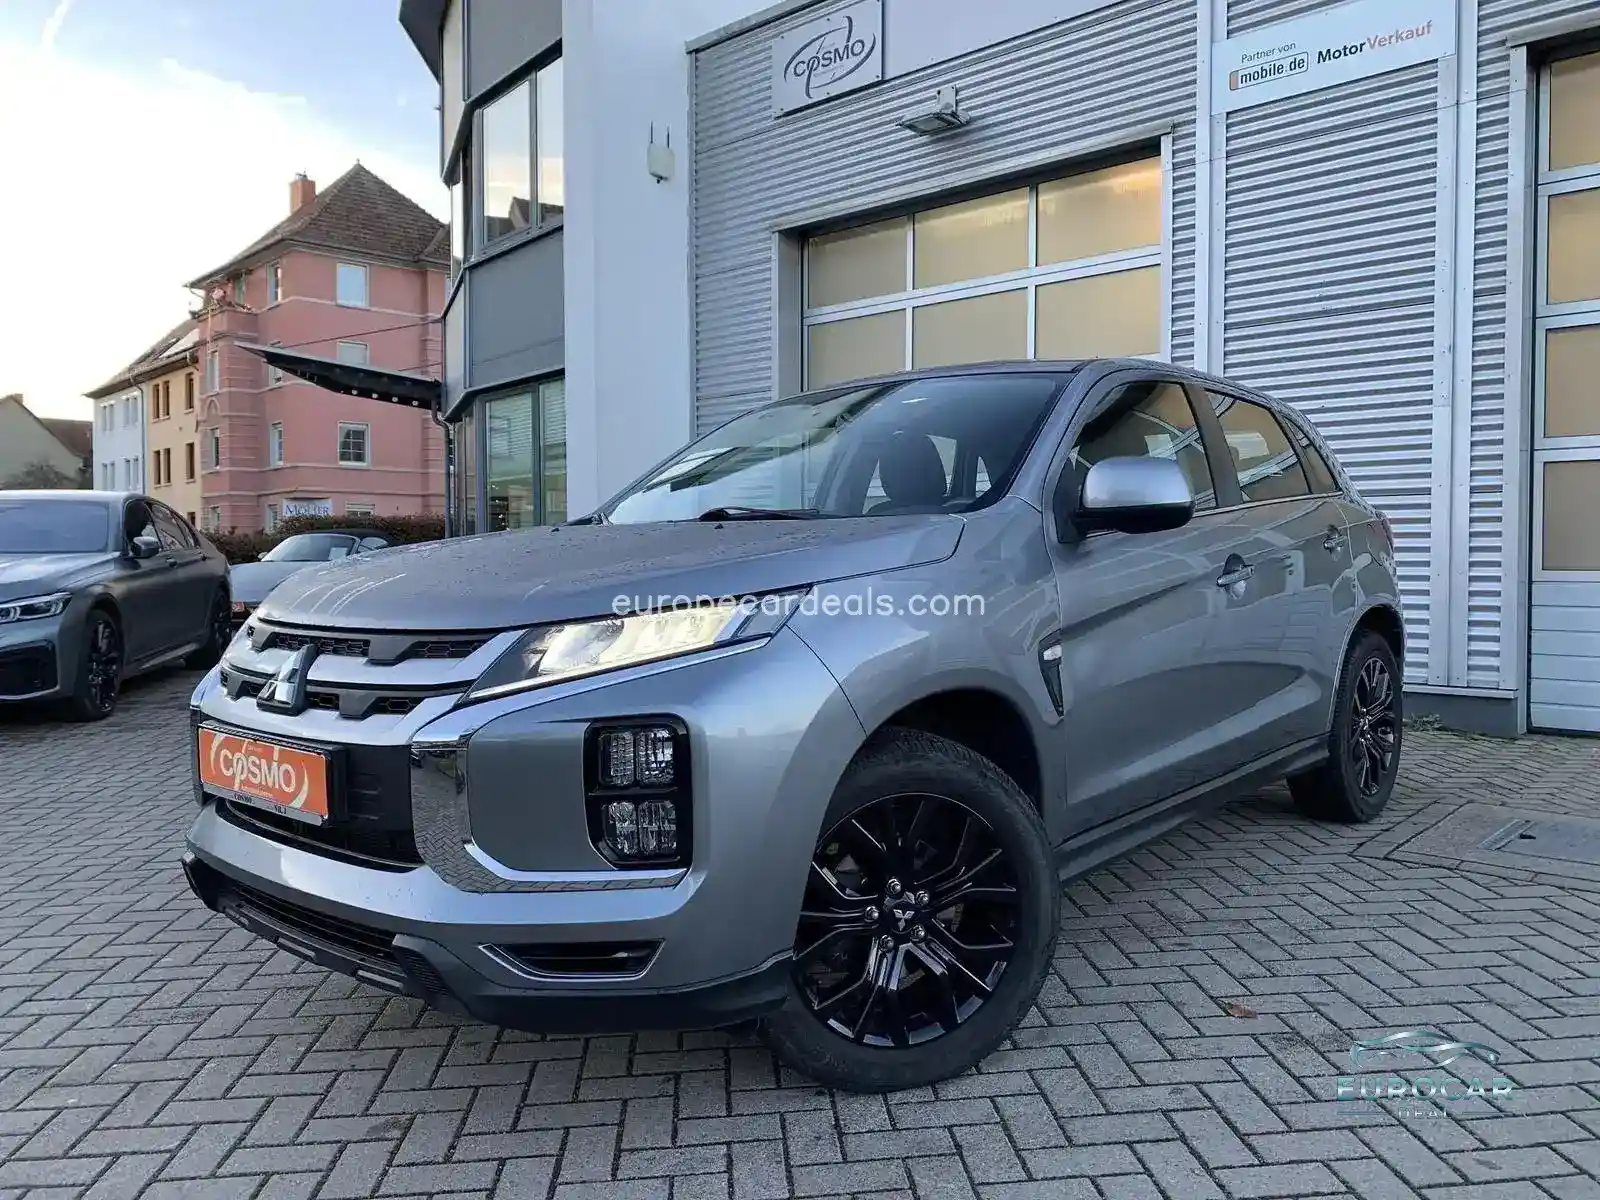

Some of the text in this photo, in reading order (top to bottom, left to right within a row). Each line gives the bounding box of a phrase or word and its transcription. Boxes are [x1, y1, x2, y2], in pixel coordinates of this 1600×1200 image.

[793, 39, 866, 77] COSMO
[1241, 42, 1297, 64] Partner von
[1240, 57, 1305, 84] mobile.de
[219, 748, 297, 793] COSMO
